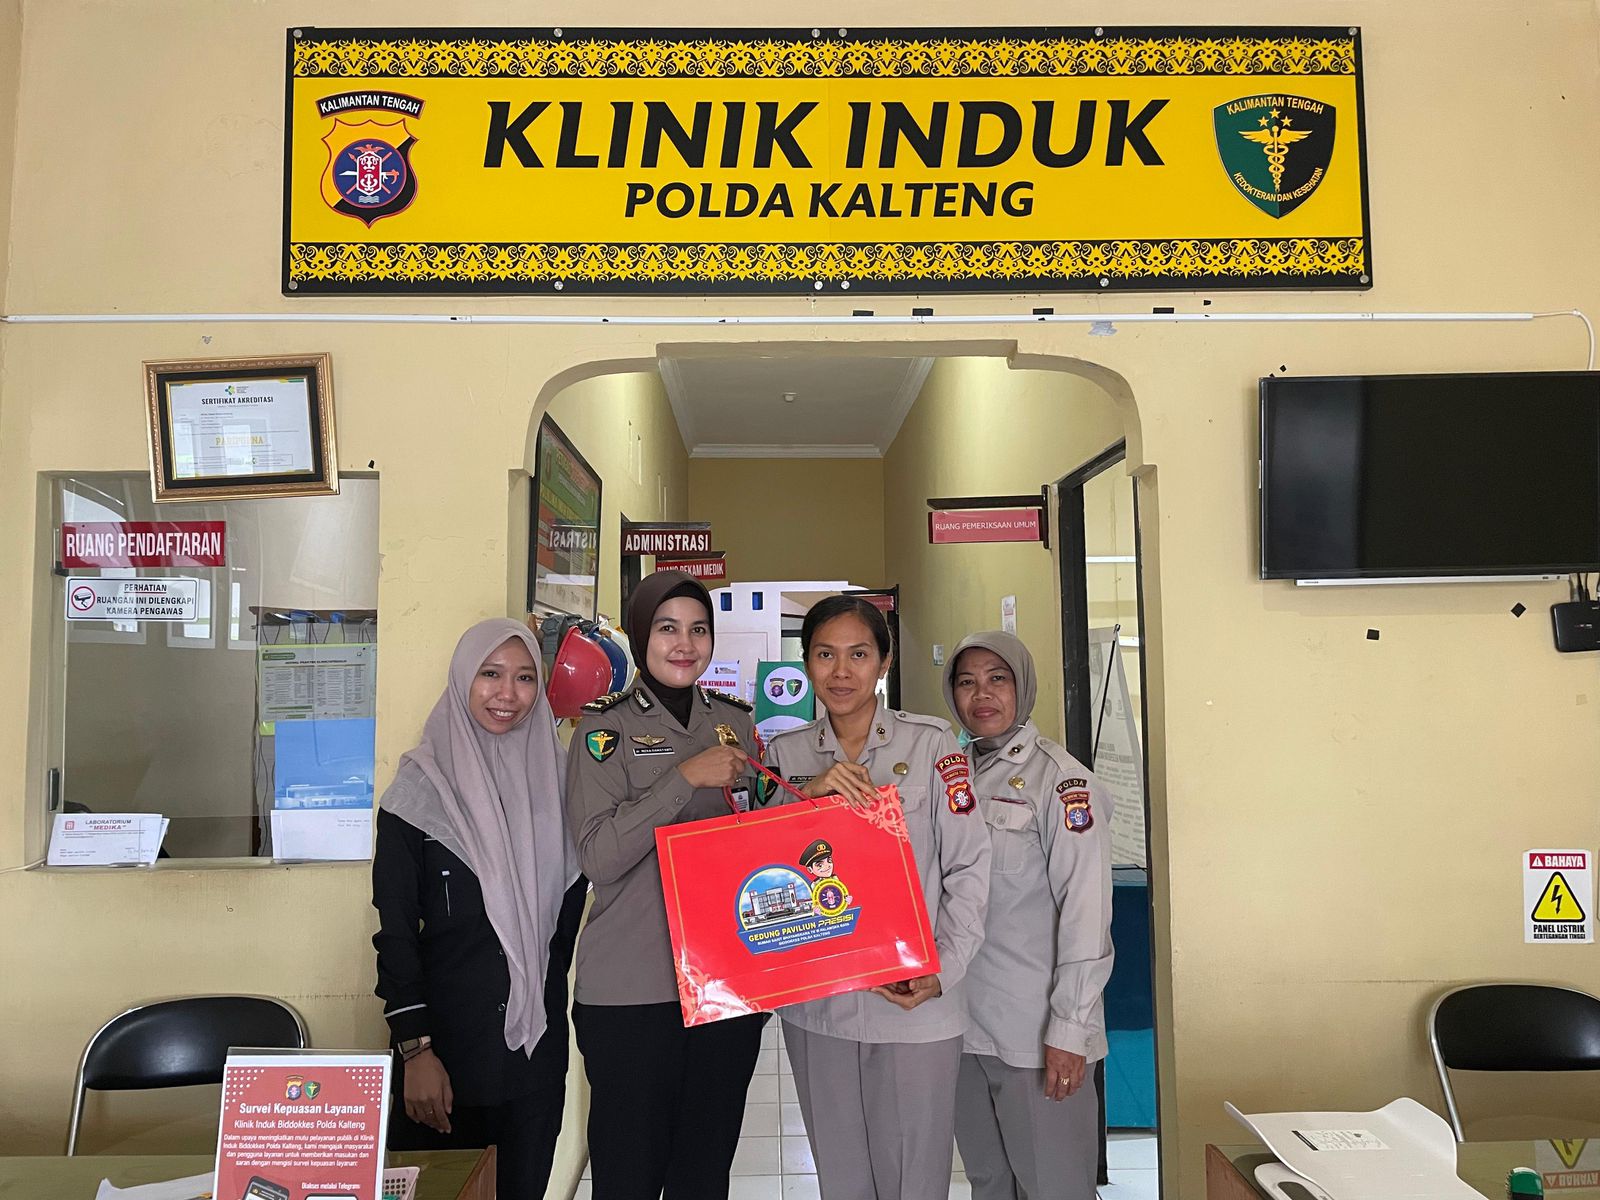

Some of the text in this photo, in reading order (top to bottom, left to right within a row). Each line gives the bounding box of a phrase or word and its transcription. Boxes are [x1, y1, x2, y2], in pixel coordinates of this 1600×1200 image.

[320, 93, 421, 115] KALIMANTAN TENGAH
[1226, 96, 1324, 115] KALIMANTAN TENGAH
[483, 97, 1171, 170] KLINIK INDUK
[1233, 166, 1323, 202] KEDOKTERAN DAN KESEHATAN
[624, 180, 1035, 218] POLDA KALTENG
[201, 396, 274, 405] SERTIFIKAT AKREDITASI
[935, 520, 1036, 530] RUANG PEMERIKSAAN UMUM
[66, 531, 221, 557] RUANG PENDAFTARAN
[625, 533, 709, 552] ADMINISTRASI
[703, 563, 724, 576] MEDIK
[124, 583, 167, 592] PERHATIAN
[96, 596, 194, 605] RUANGAN INI DILENGKAPI
[106, 606, 183, 616] KAMERA PENGAWAS
[938, 755, 966, 771] POLDA
[1057, 779, 1084, 792] POLDA
[1544, 855, 1584, 868] BAHAYA
[748, 914, 854, 943] GEDUNG PAVILIUN PRESISI
[1533, 924, 1585, 933] PANEL LISTRIK
[239, 1102, 366, 1116] Survei Kepuasan Layanan
[234, 1119, 366, 1131] Klinik Induk Biddokkes Polda Kalteng
[257, 1134, 294, 1142] meningkatkan
[309, 1134, 336, 1142] pelayanan
[336, 1134, 353, 1142] publik
[318, 1142, 343, 1151] mengajak
[343, 1142, 374, 1150] masyarakat
[263, 1151, 284, 1159] layanan
[250, 1159, 271, 1168] dengan
[310, 1160, 336, 1168] kepuasan
